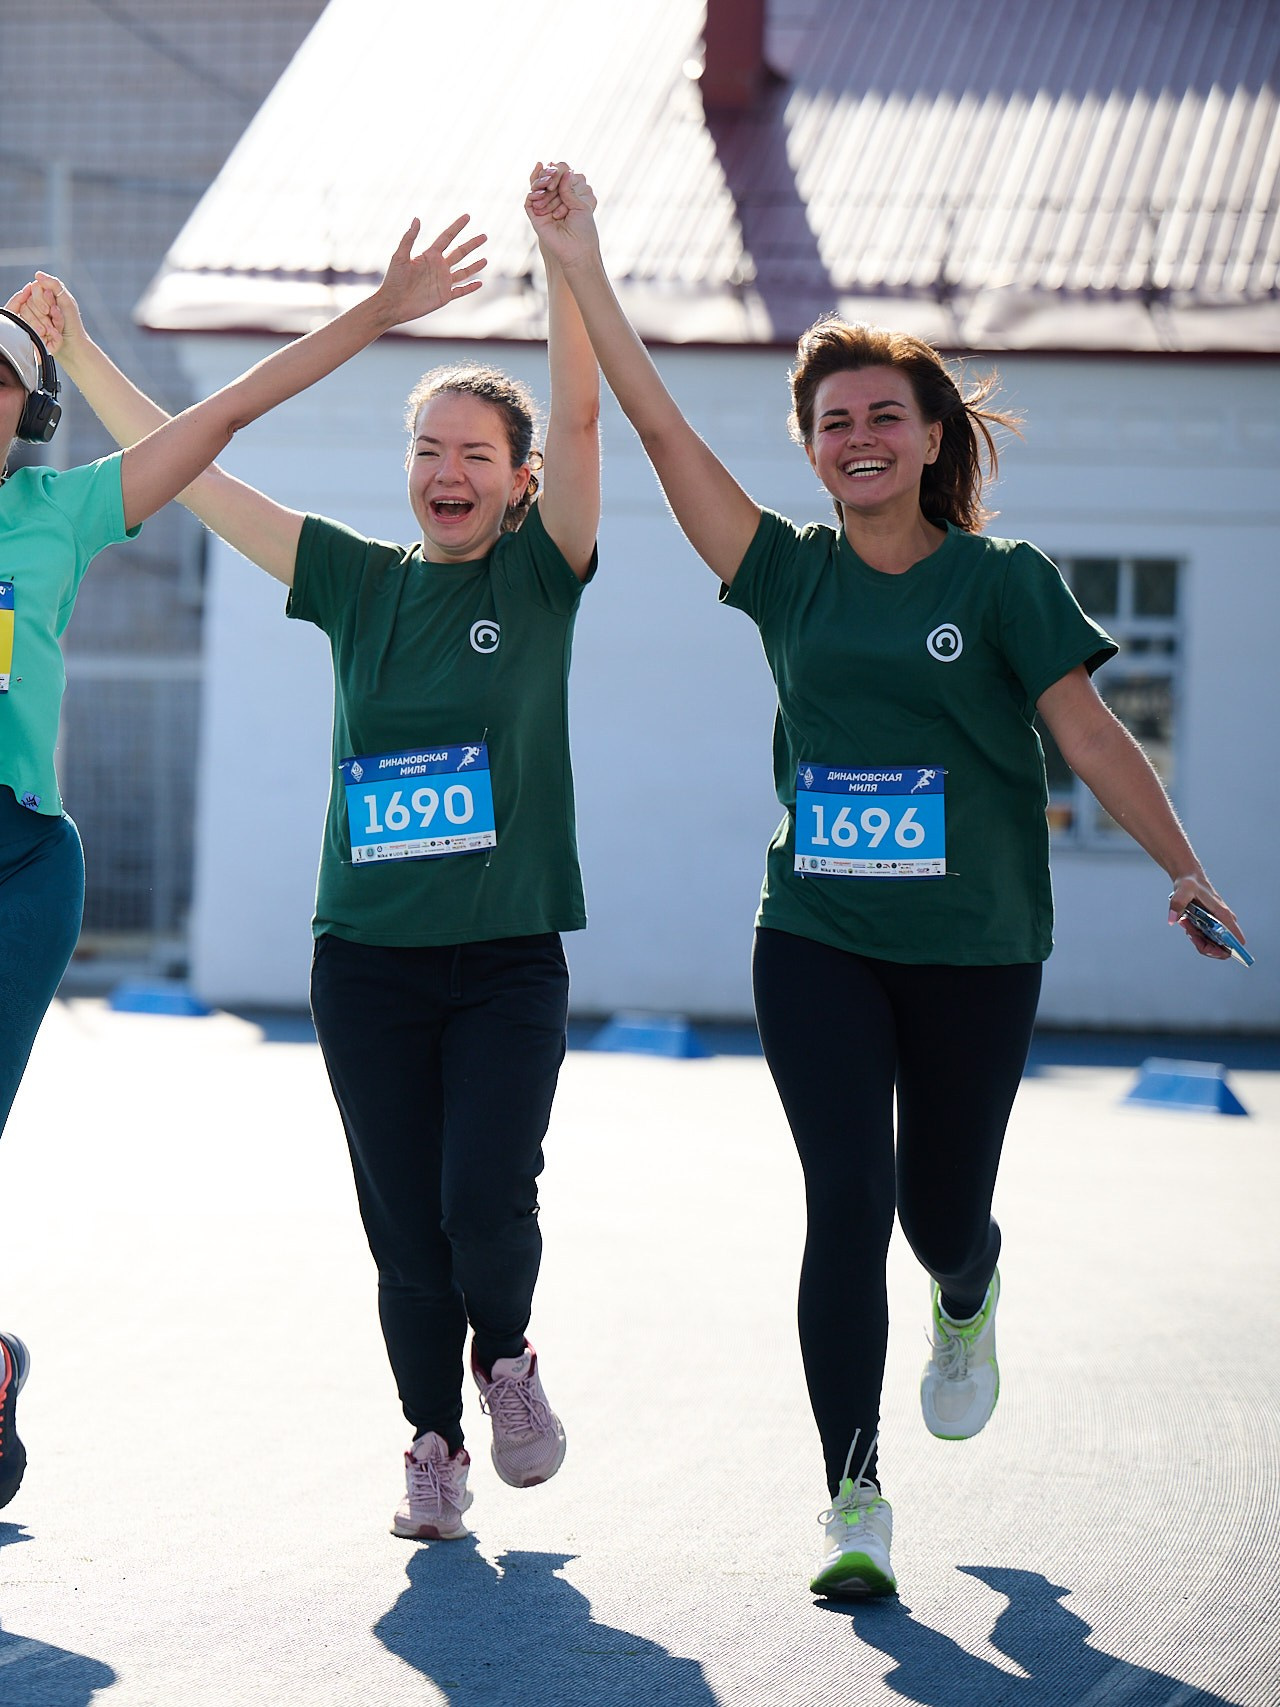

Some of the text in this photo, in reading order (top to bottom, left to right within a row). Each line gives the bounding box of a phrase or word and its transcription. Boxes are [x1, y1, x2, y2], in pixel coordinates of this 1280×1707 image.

[378, 752, 448, 769] ДИНАМОВСКАЯ
[399, 764, 427, 776] МИЛЯ
[827, 771, 903, 782] ДИНАМОВСКАЯ
[848, 783, 878, 792] МИЛЯ
[363, 784, 474, 834] 1690
[811, 804, 926, 849] 1696
